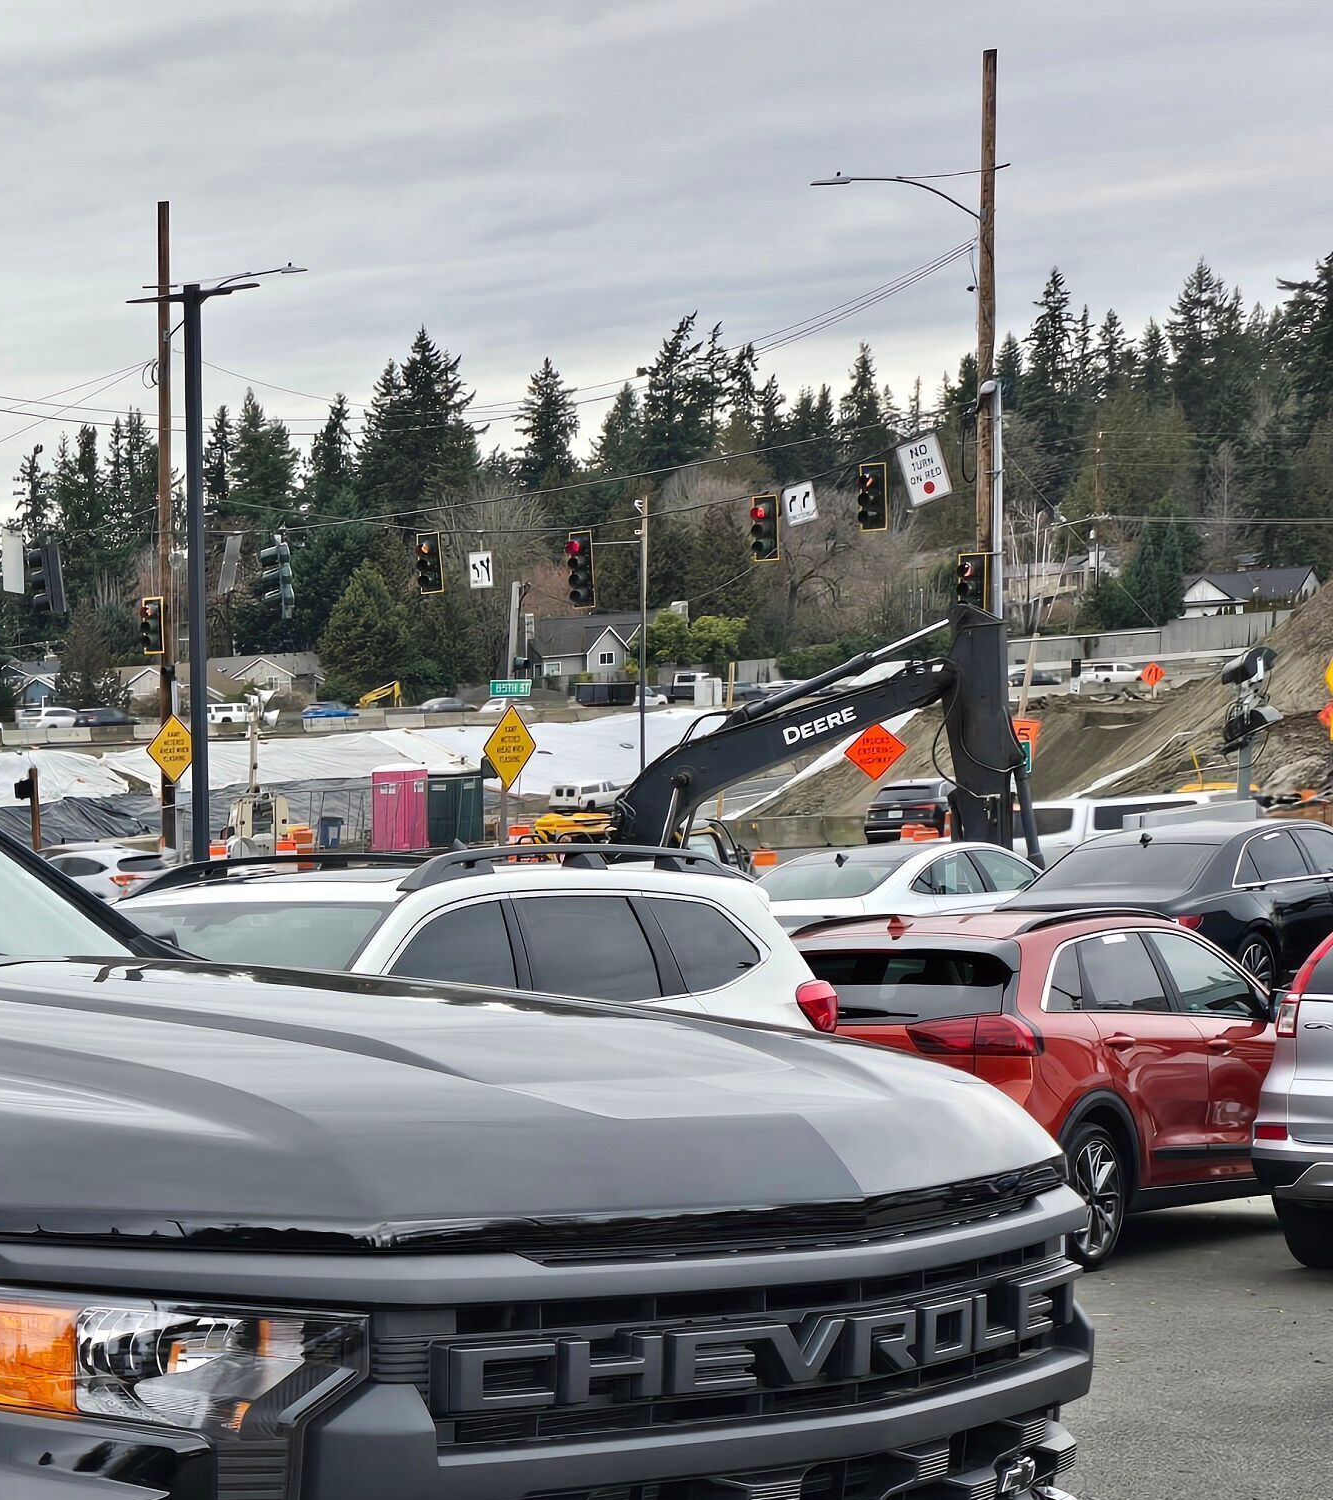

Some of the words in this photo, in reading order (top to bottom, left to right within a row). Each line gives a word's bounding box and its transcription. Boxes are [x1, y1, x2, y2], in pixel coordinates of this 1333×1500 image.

[909, 444, 928, 460] NO
[911, 456, 934, 472] TURN
[910, 474, 923, 486] ON
[924, 466, 942, 480] RED
[519, 682, 530, 694] ST
[782, 706, 858, 746] DEERE
[433, 1262, 1084, 1412] CHEVROLET
